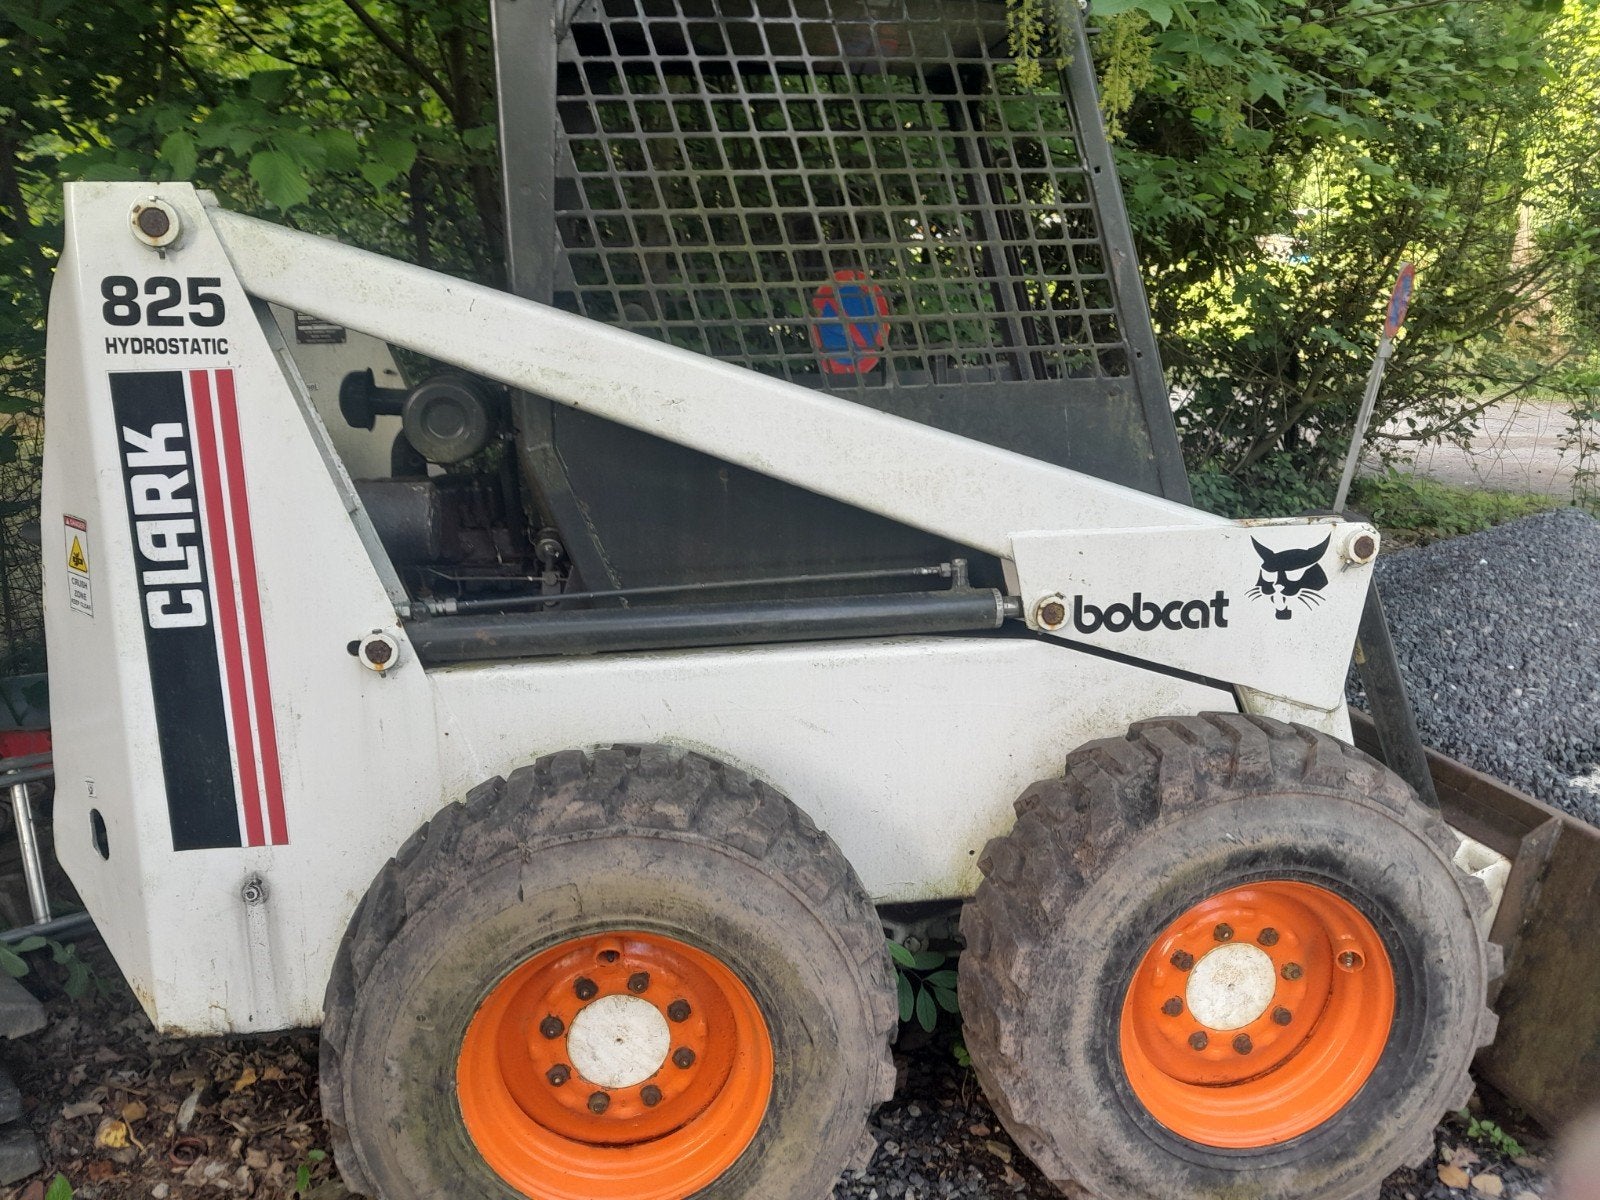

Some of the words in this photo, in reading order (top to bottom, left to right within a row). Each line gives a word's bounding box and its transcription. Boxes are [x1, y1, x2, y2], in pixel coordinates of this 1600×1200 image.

[101, 275, 225, 327] 825
[105, 337, 229, 355] HYDROSTATIC
[122, 422, 207, 629] CLARK
[74, 590, 87, 601] ZONE
[1074, 590, 1230, 634] bobcat
